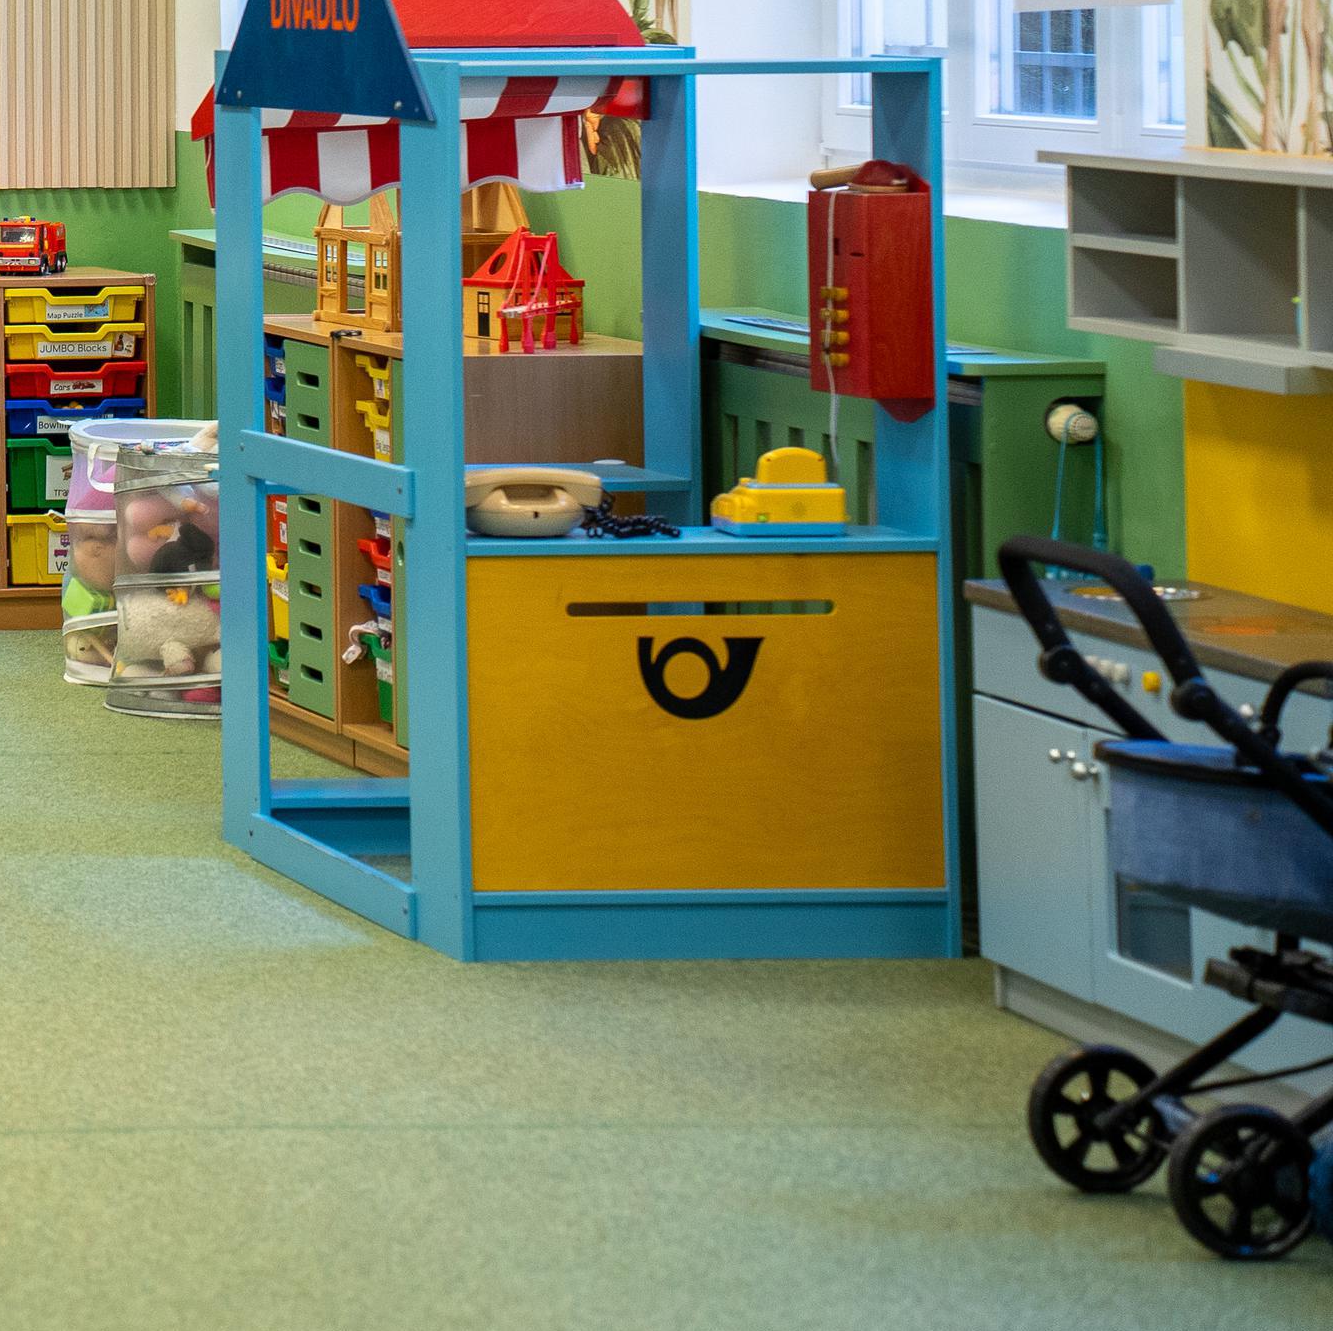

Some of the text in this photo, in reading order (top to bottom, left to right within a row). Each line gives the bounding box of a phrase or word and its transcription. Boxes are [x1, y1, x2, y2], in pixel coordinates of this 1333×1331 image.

[47, 311, 83, 321] Map Puzzle
[40, 343, 107, 353] JUMBO Blocks
[53, 382, 70, 391] Cars
[38, 421, 70, 430] Bowlin
[54, 489, 69, 497] Tra
